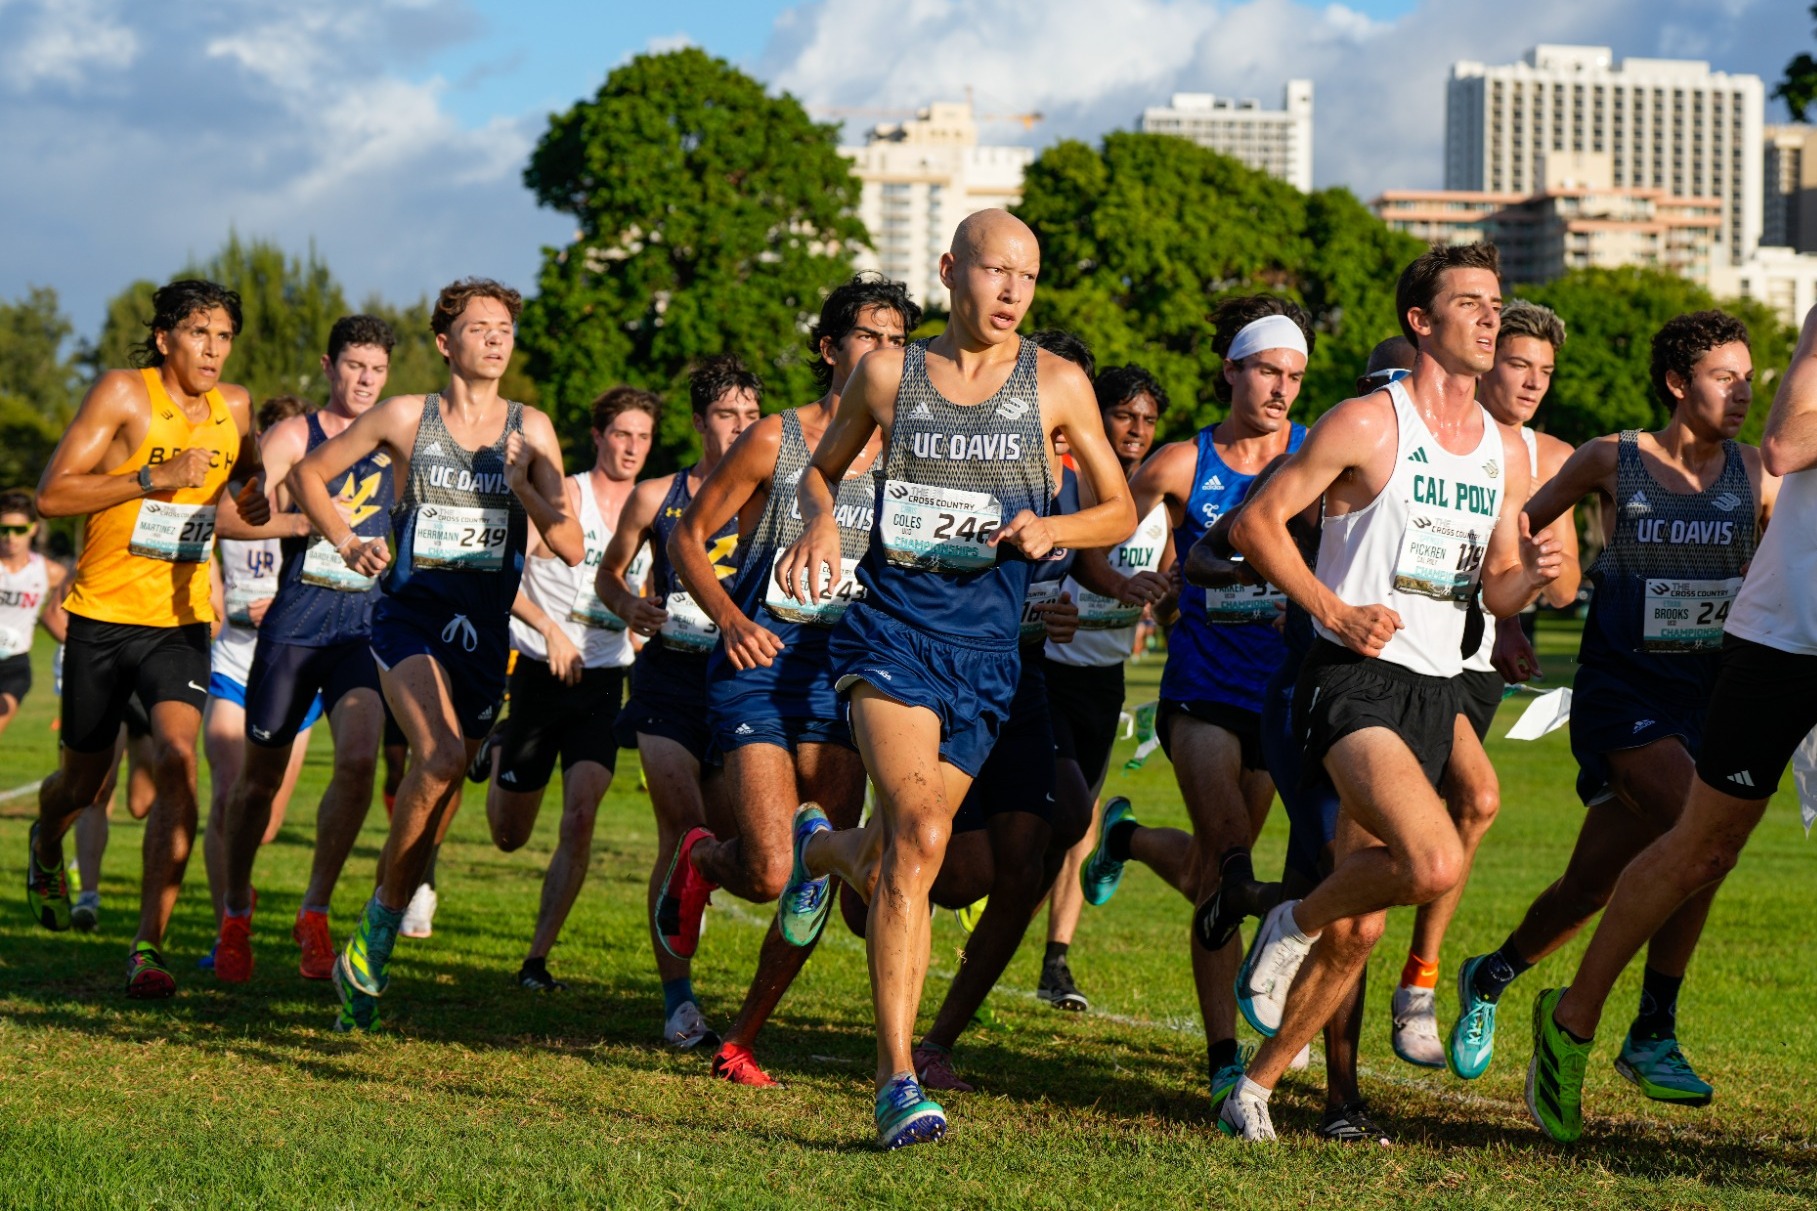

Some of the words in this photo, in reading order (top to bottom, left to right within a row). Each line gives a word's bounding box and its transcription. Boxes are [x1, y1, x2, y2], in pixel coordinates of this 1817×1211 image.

[913, 432, 943, 459] UC
[949, 432, 1020, 460] DAVIS
[430, 465, 454, 488] UC
[908, 495, 935, 506] CROSS
[936, 499, 975, 511] COUNTRY
[1413, 474, 1449, 508] CAL
[1455, 482, 1497, 517] POLY
[140, 521, 177, 536] MARTINEZ
[438, 514, 460, 523] CROSS
[460, 516, 491, 524] COUNTRY
[833, 504, 875, 532] AVIS
[893, 513, 922, 529] COLES
[933, 512, 999, 544] 246
[179, 521, 214, 542] 212
[417, 528, 460, 542] HERRMANN
[460, 527, 507, 548] 249
[1431, 525, 1455, 537] CROSS
[1638, 519, 1665, 543] UC
[1670, 520, 1734, 545] DAVIS
[894, 536, 979, 557] CHAMPIONSHIPS
[1118, 546, 1154, 567] POLY
[1409, 541, 1447, 560] PICKREN
[1671, 582, 1690, 591] THE
[1654, 608, 1690, 620] BROOKS
